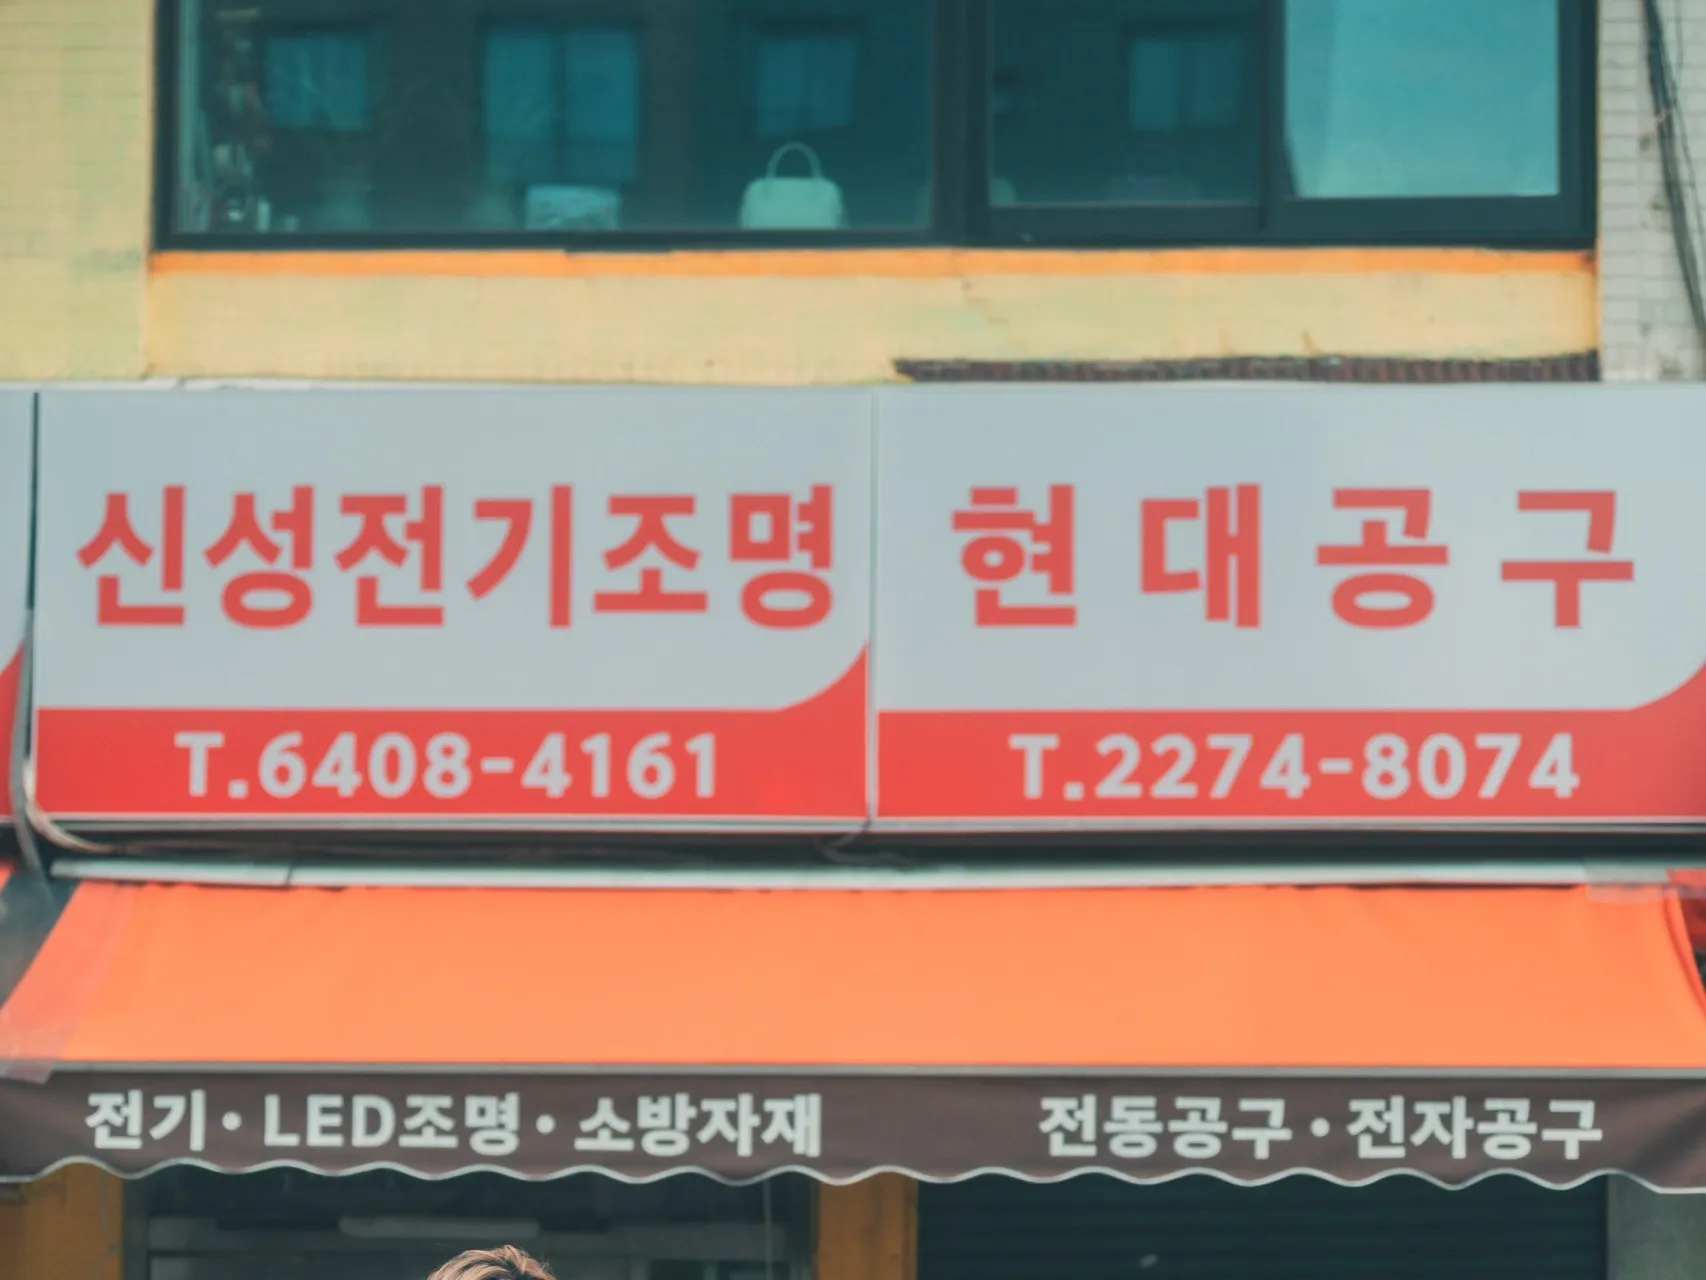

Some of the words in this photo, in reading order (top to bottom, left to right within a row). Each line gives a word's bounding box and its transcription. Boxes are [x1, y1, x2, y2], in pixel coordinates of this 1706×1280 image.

[76, 483, 834, 631] 신성전기조명
[951, 483, 1635, 630] 현대공구
[174, 731, 716, 799] T.6408-4161
[1008, 732, 1582, 801] T.2274-8074
